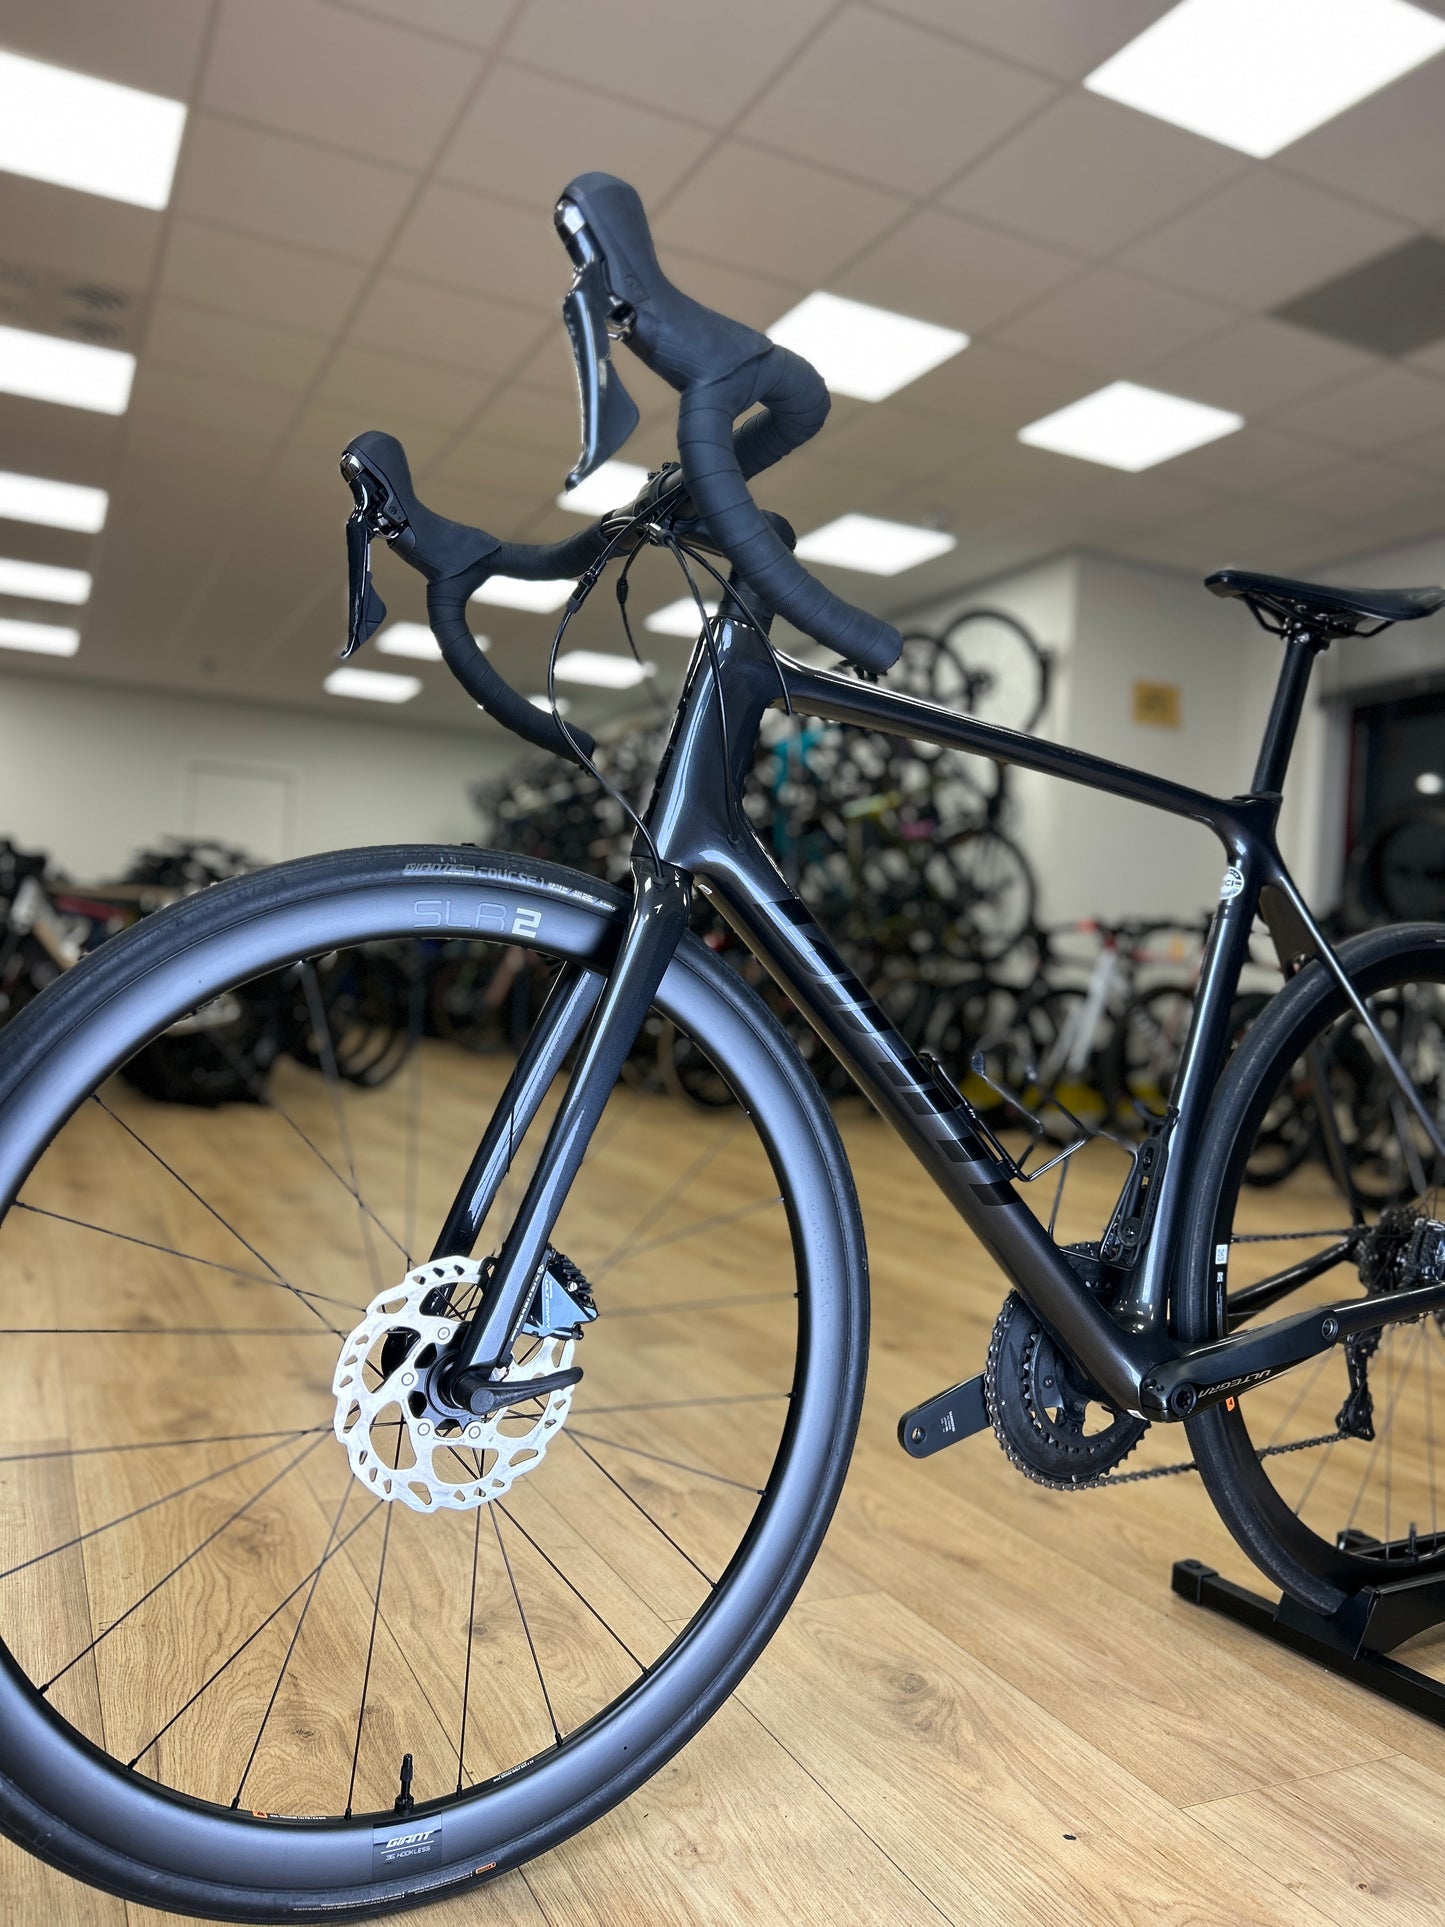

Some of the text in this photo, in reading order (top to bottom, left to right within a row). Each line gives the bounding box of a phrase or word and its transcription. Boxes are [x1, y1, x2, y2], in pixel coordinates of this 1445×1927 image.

[1197, 1369, 1272, 1399] ULTEGRA
[386, 1831, 435, 1848] GIANT
[396, 1845, 432, 1858] HOOKLESS
